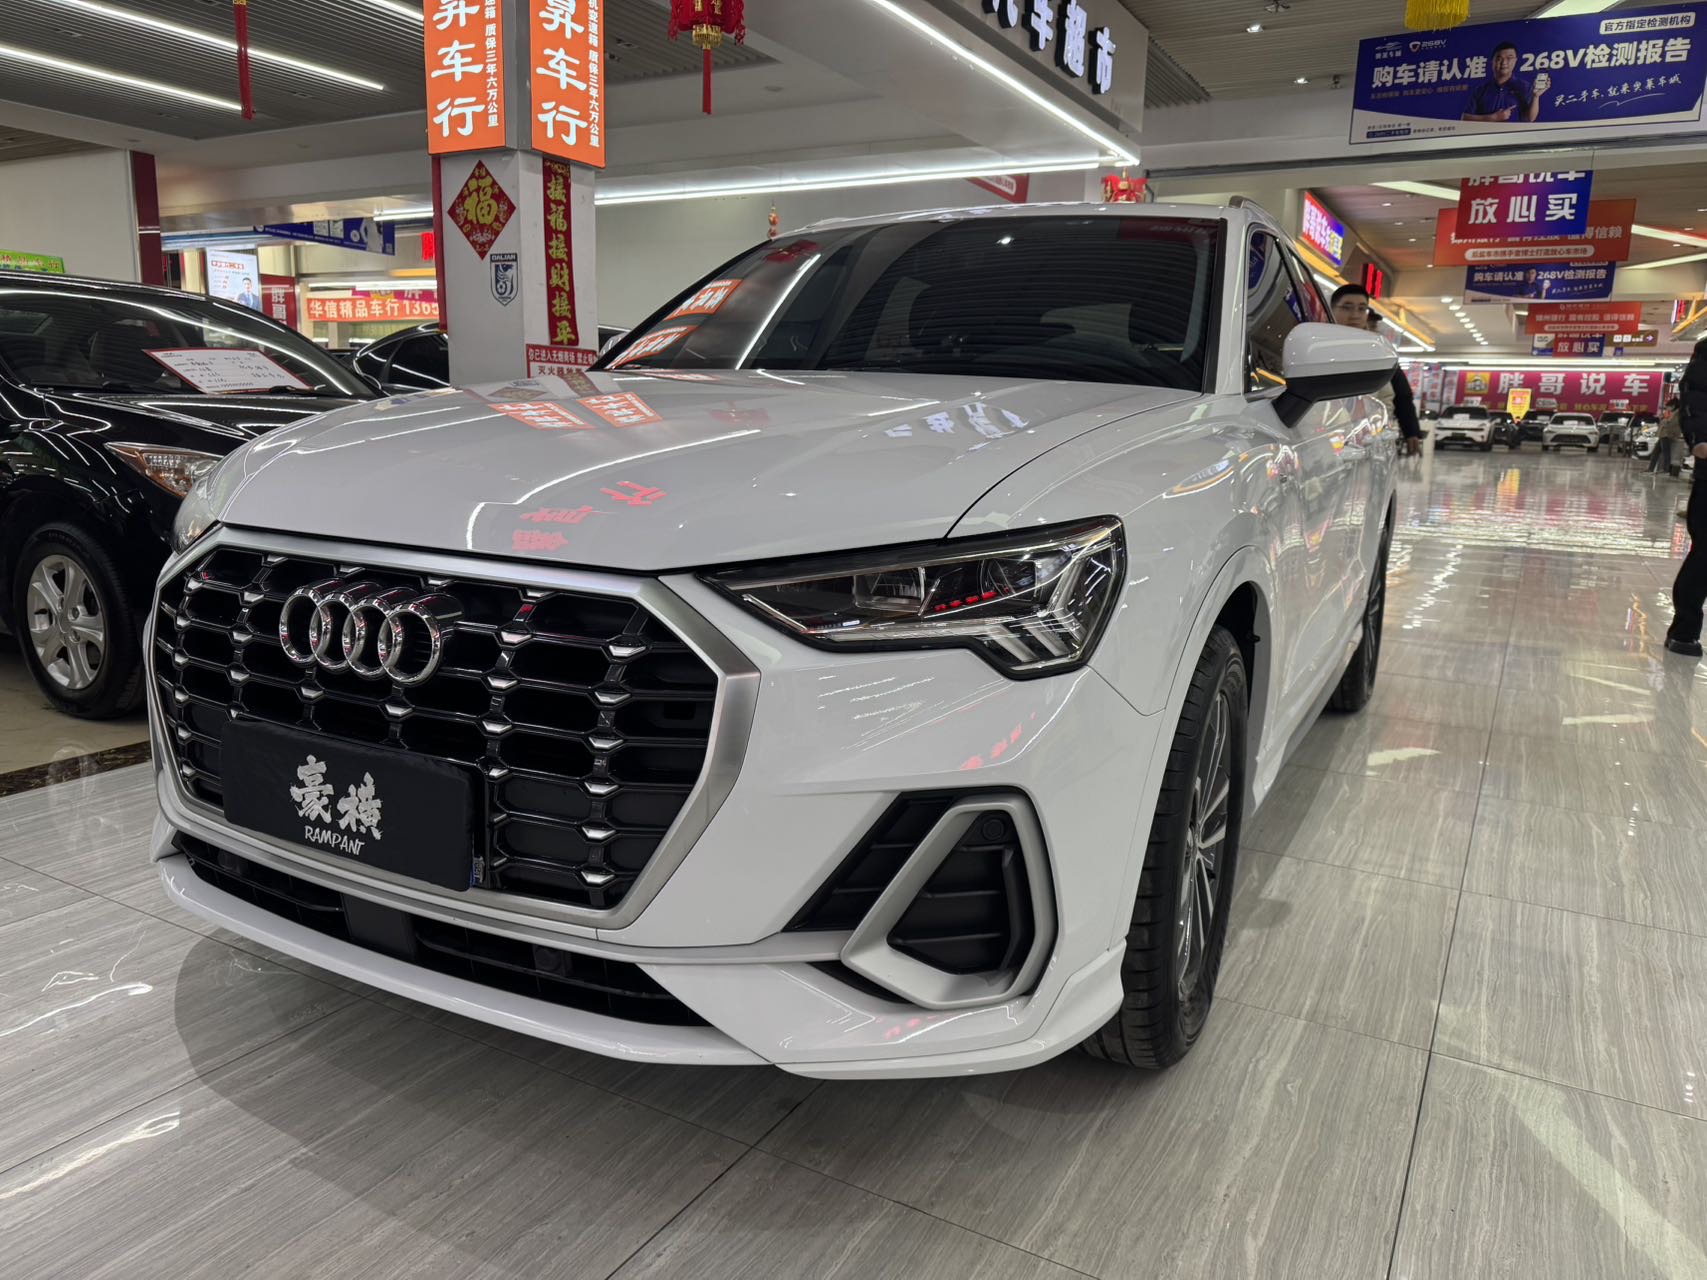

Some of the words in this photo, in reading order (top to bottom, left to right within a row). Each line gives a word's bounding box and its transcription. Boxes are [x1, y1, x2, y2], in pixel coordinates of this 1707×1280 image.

[1604, 18, 1691, 32] 官方指定检测机构
[1372, 55, 1488, 88] 购车请认准
[1519, 37, 1691, 72] 268V检测报告
[485, 23, 499, 128] 质保三年六万公里
[536, 0, 588, 146] 昇车行
[588, 49, 600, 147] 质保三年六万公里
[464, 175, 498, 225] 福
[1468, 193, 1578, 225] 放心买
[491, 253, 517, 262] DALIAN
[1497, 372, 1651, 397] 胖哥说车
[289, 754, 384, 840] 豪横
[304, 825, 366, 856] RAMPANT
